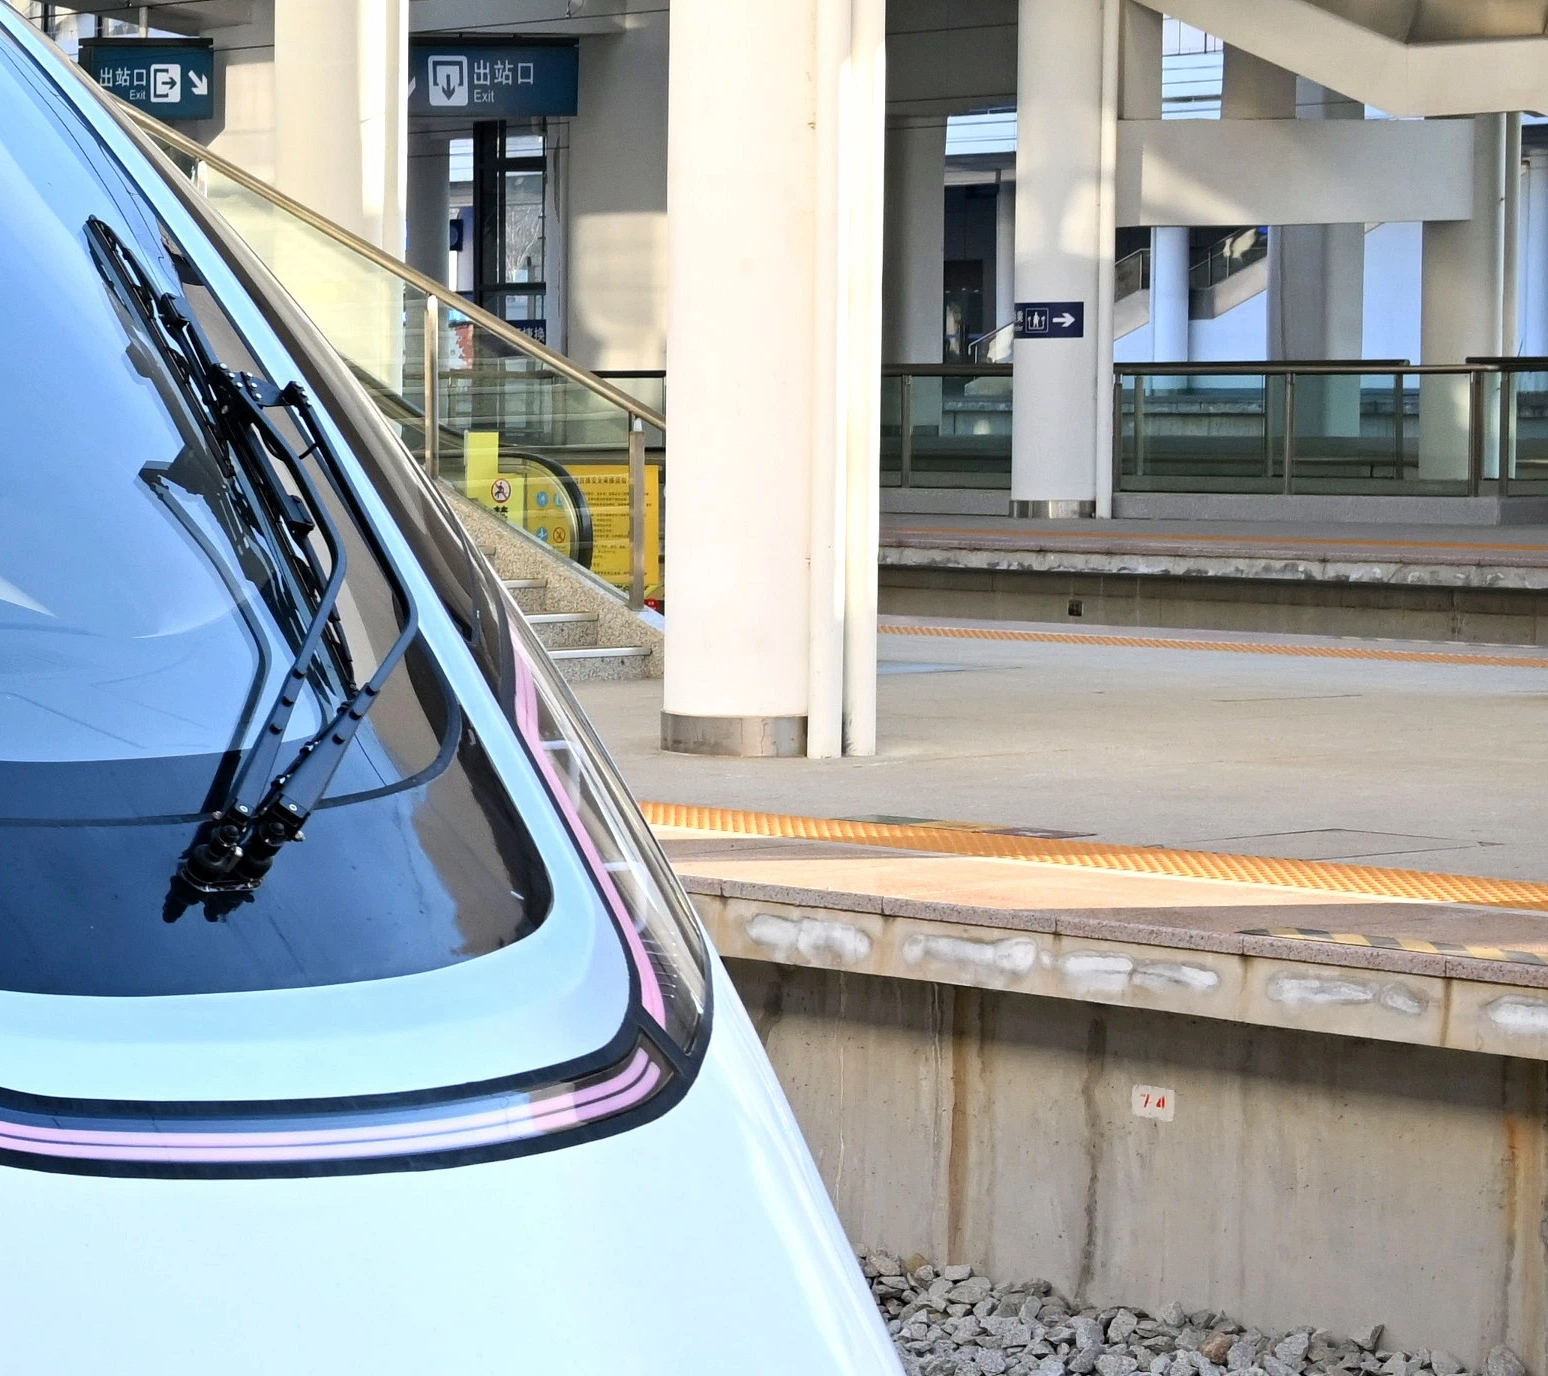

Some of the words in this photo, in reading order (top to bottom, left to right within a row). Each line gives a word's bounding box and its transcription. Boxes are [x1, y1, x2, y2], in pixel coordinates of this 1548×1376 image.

[99, 67, 147, 87] 出站口
[474, 59, 534, 86] 出站口
[129, 89, 146, 100] Exit
[473, 89, 495, 103] Exit
